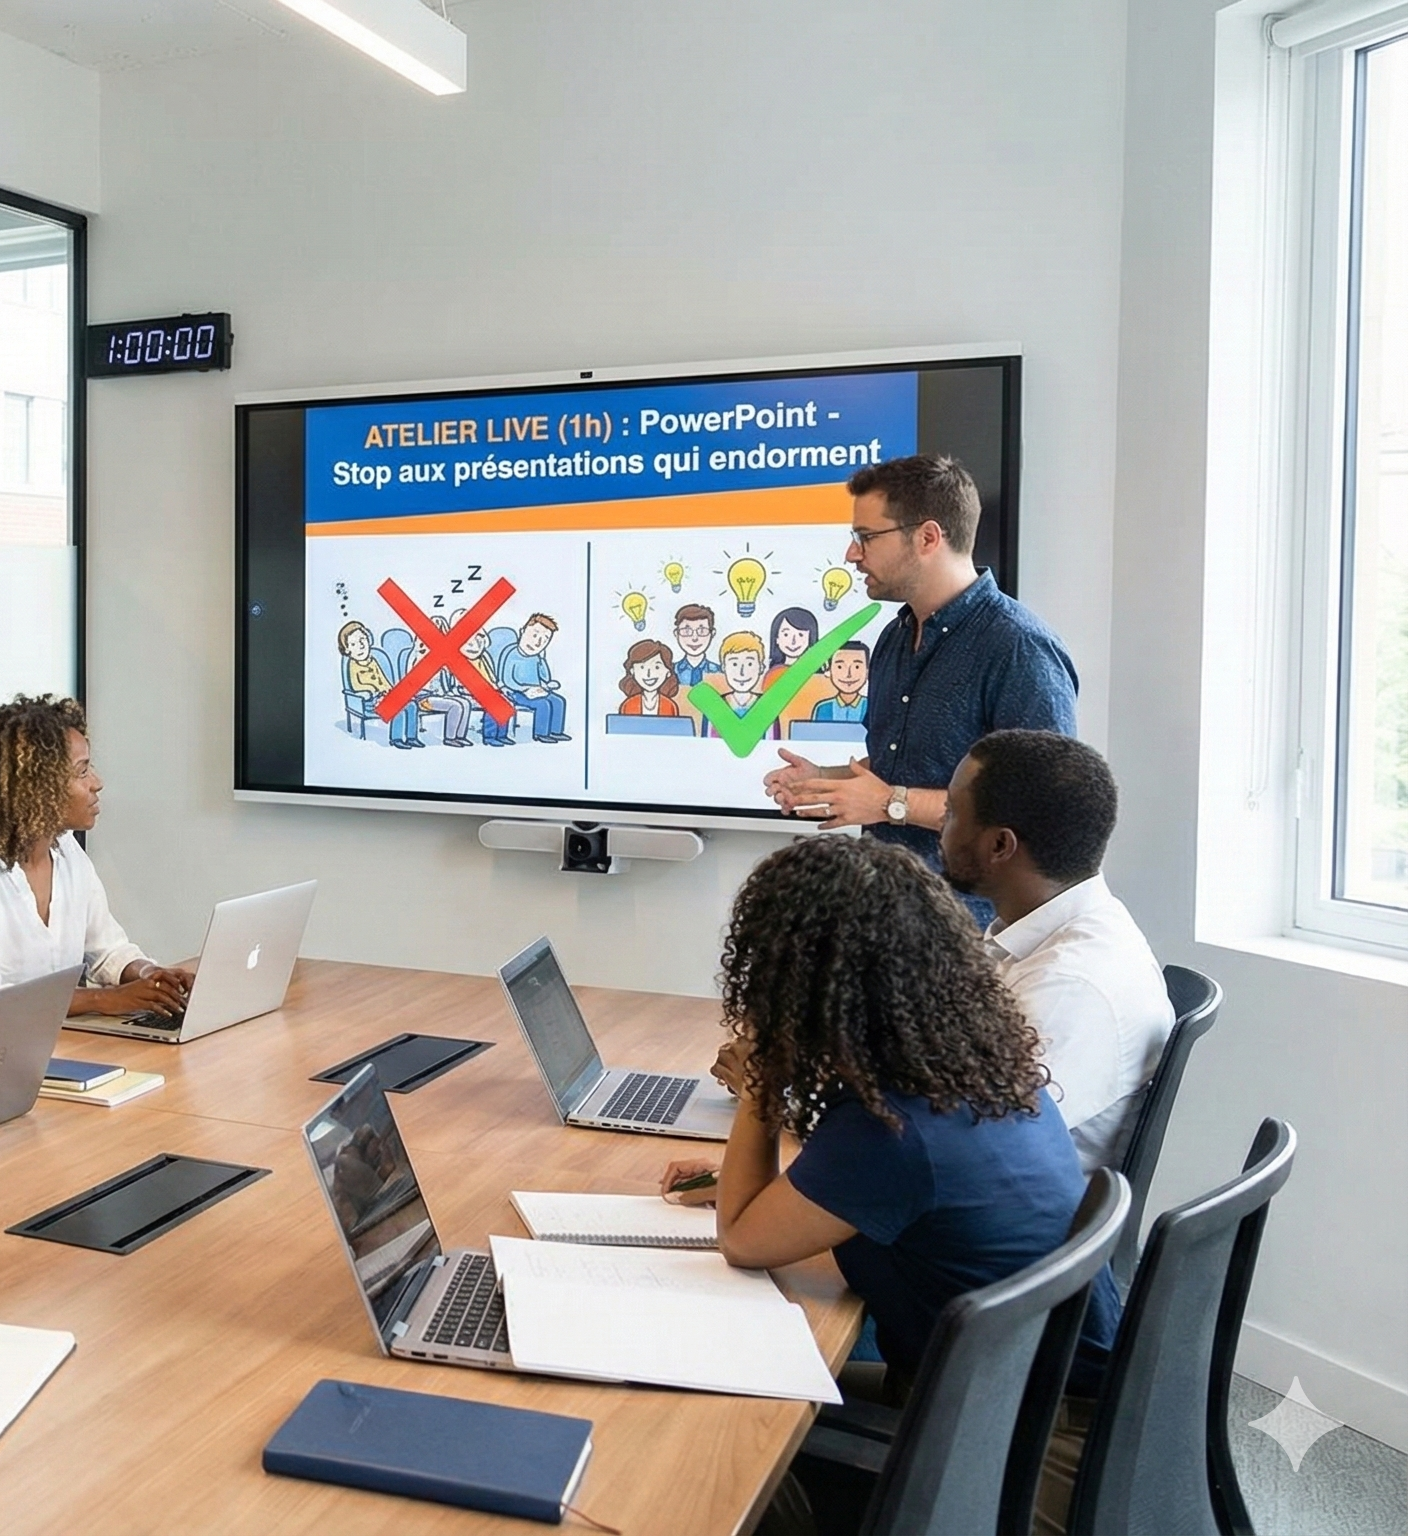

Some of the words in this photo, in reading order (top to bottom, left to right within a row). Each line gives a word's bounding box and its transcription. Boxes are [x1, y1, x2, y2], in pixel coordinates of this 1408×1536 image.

[108, 325, 215, 364] 1:00:00
[364, 419, 478, 449] ATELIER
[487, 415, 549, 443] LIVE
[558, 411, 612, 446] (1h)
[640, 400, 818, 435] PowerPoint
[333, 461, 392, 490] Stop
[398, 462, 446, 483] aux
[454, 450, 645, 487] présentations
[653, 445, 700, 480] qui
[709, 438, 882, 471] endorment
